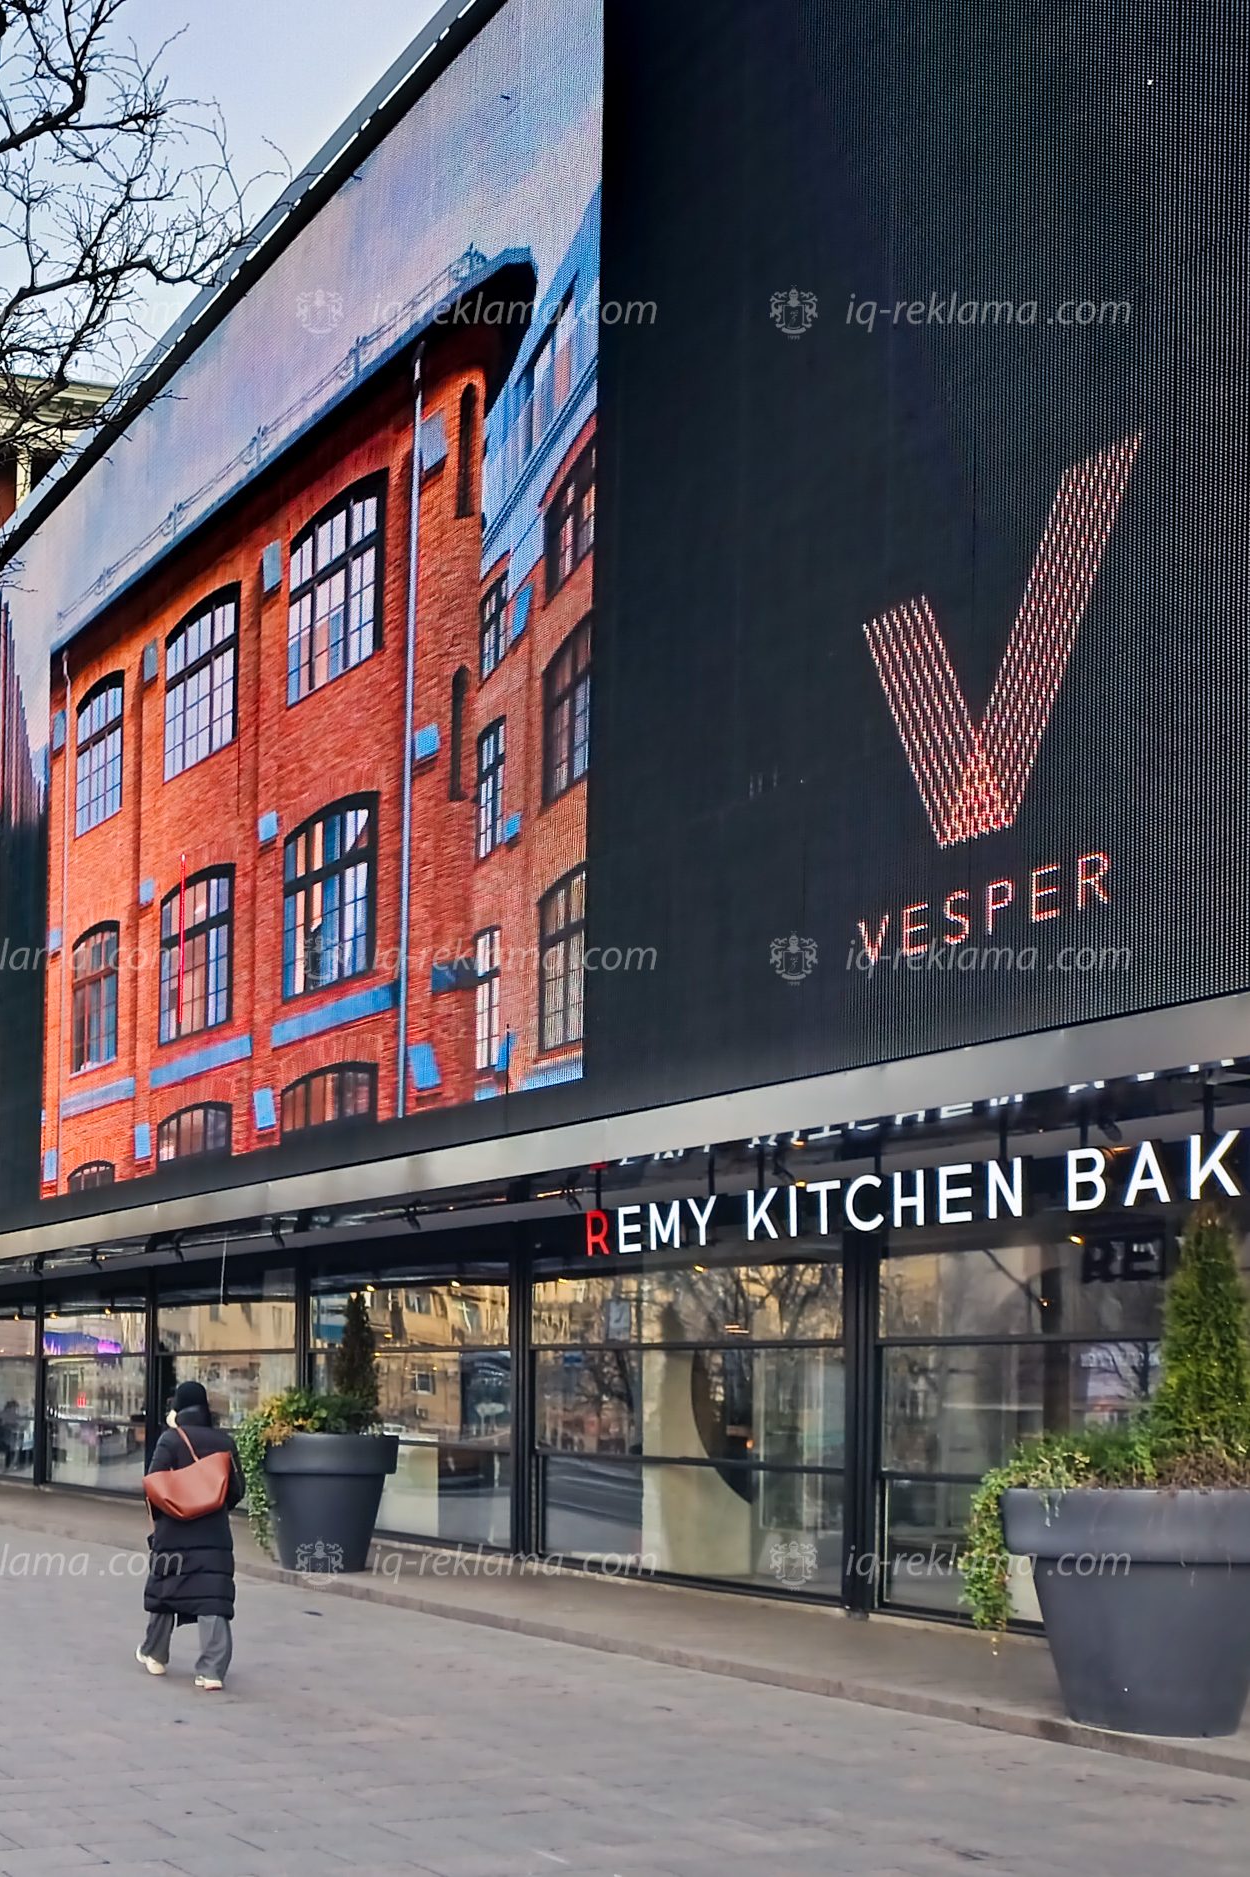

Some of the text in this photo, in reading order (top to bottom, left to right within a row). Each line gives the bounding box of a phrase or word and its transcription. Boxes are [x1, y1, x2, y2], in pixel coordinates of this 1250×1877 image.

[857, 850, 1112, 966] VESPER
[586, 1129, 1241, 1257] REMY KITCHEN BAK
